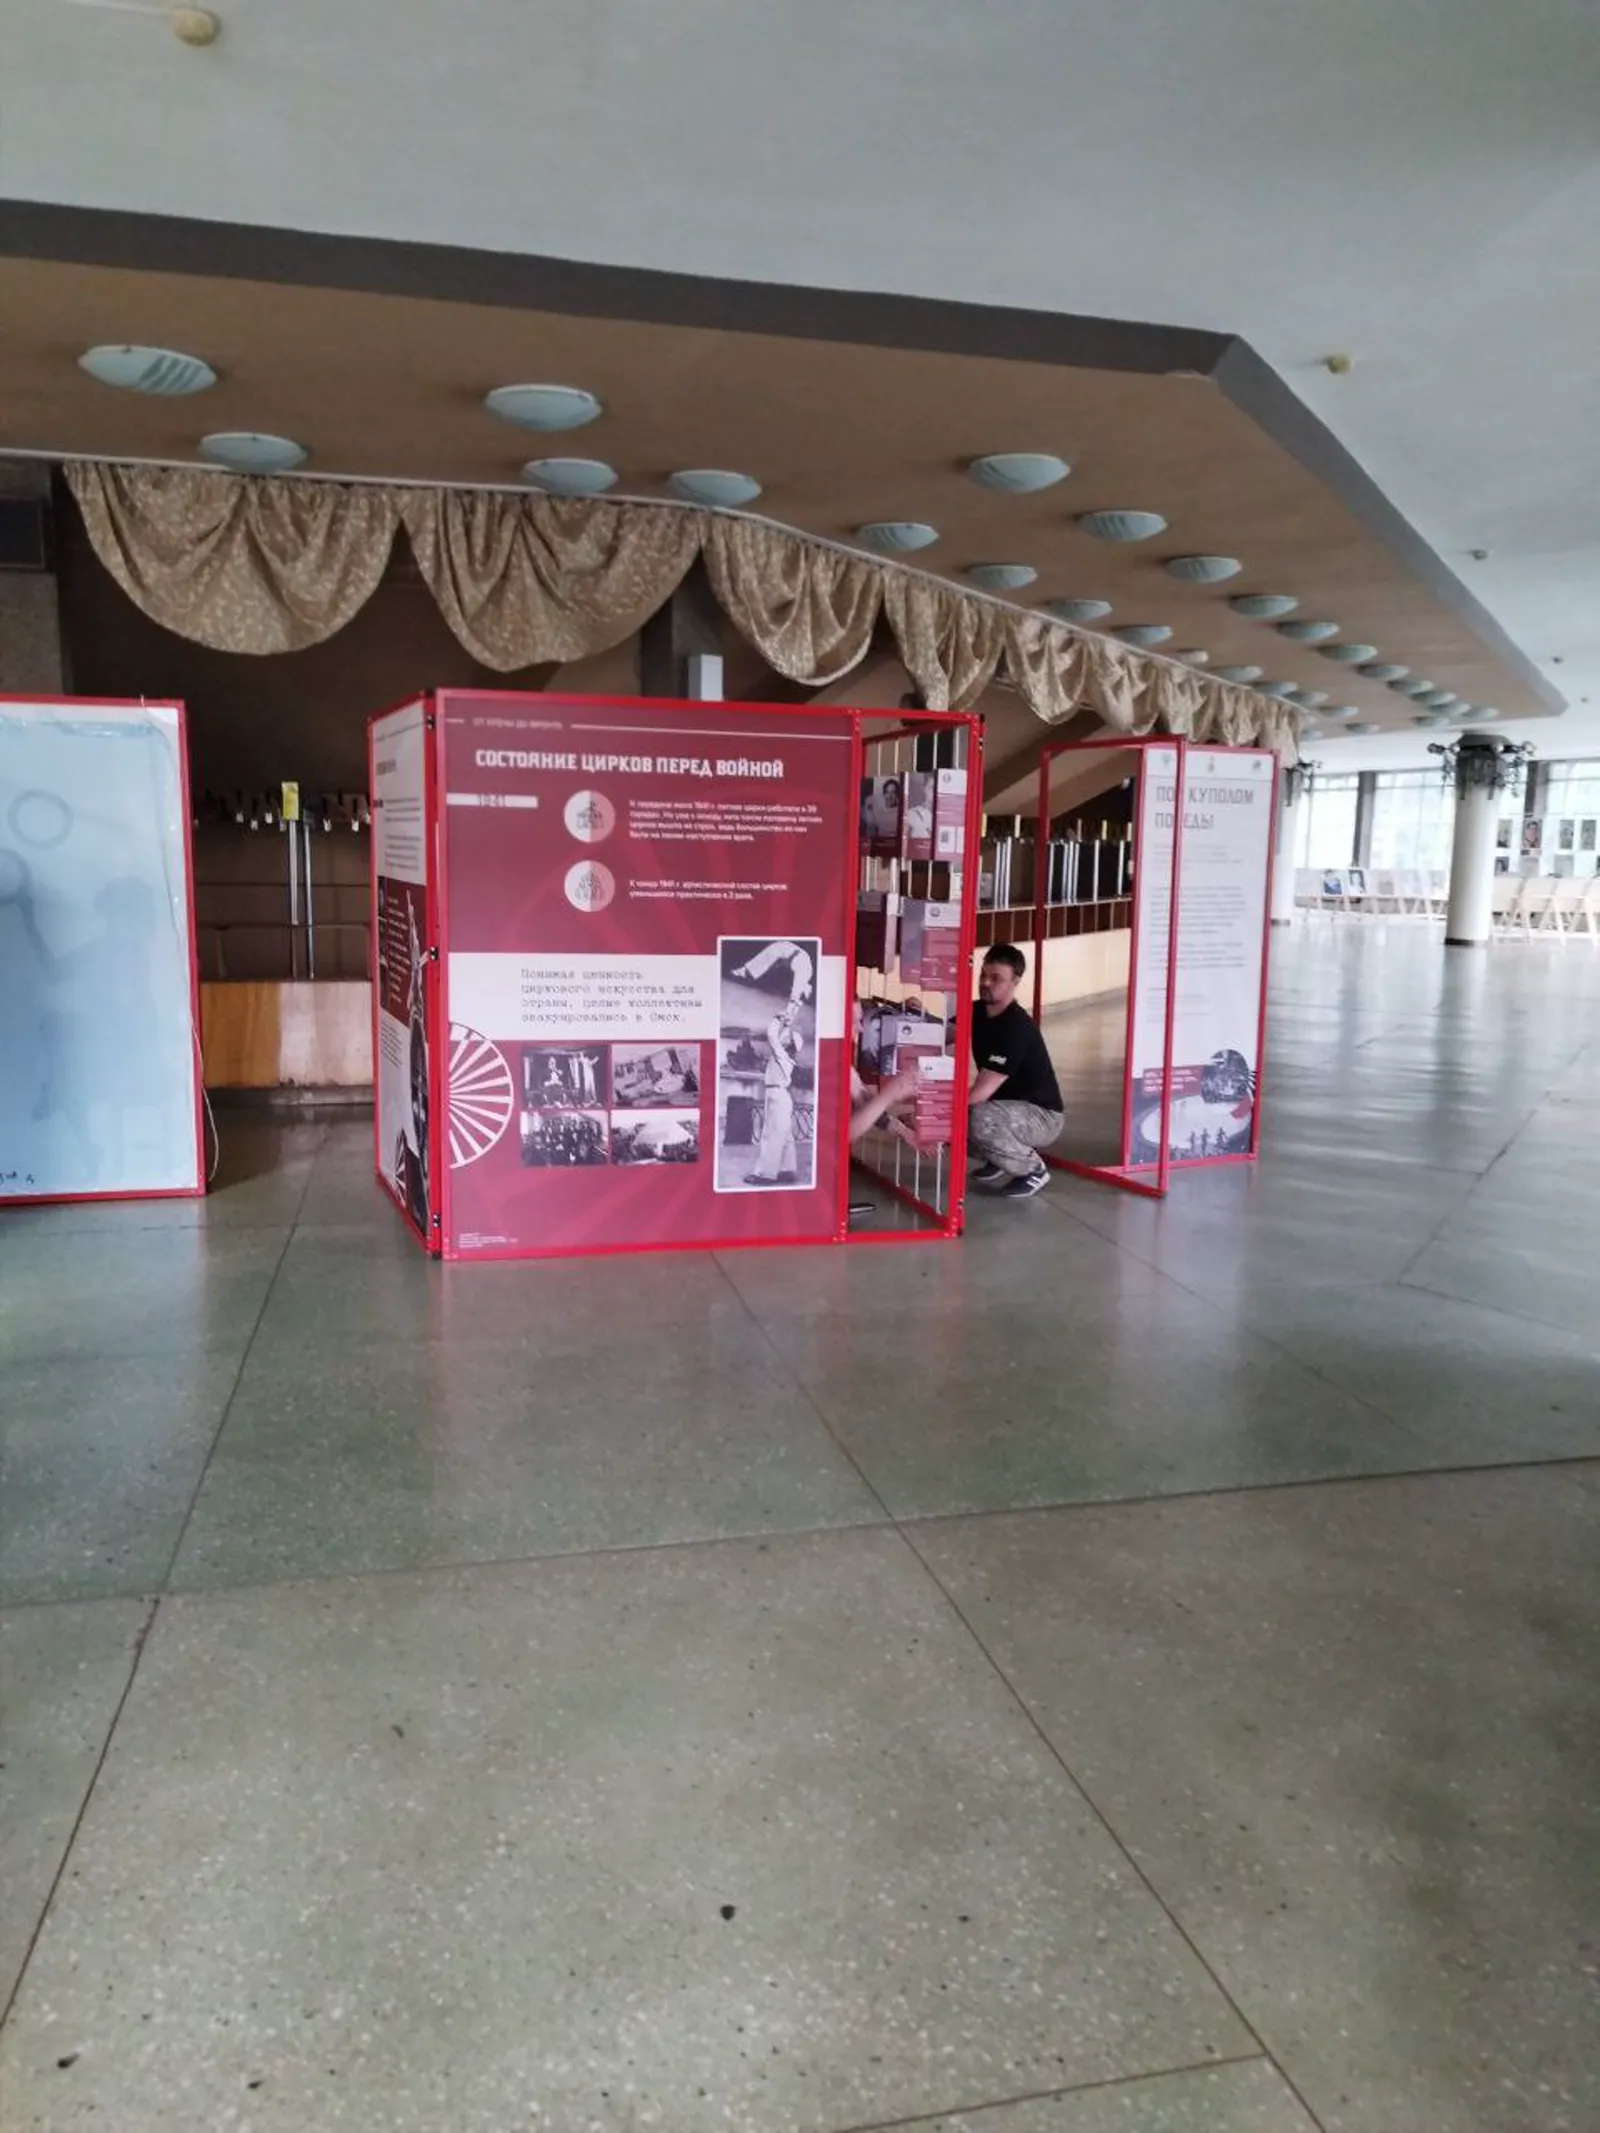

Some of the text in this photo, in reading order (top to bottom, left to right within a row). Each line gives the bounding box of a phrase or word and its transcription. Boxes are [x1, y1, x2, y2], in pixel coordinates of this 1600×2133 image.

[475, 749, 783, 777] СОСТОЯНИЕ ЦИРКОВ ПЕРЕД ВОЙНОЙ
[1187, 787, 1254, 805] КУПОЛОМ
[1154, 812, 1214, 830] ПОЕДЫ
[521, 968, 643, 980] Понимая ценность
[521, 984, 694, 996] циркового искусства для
[628, 999, 703, 1008] коллективы
